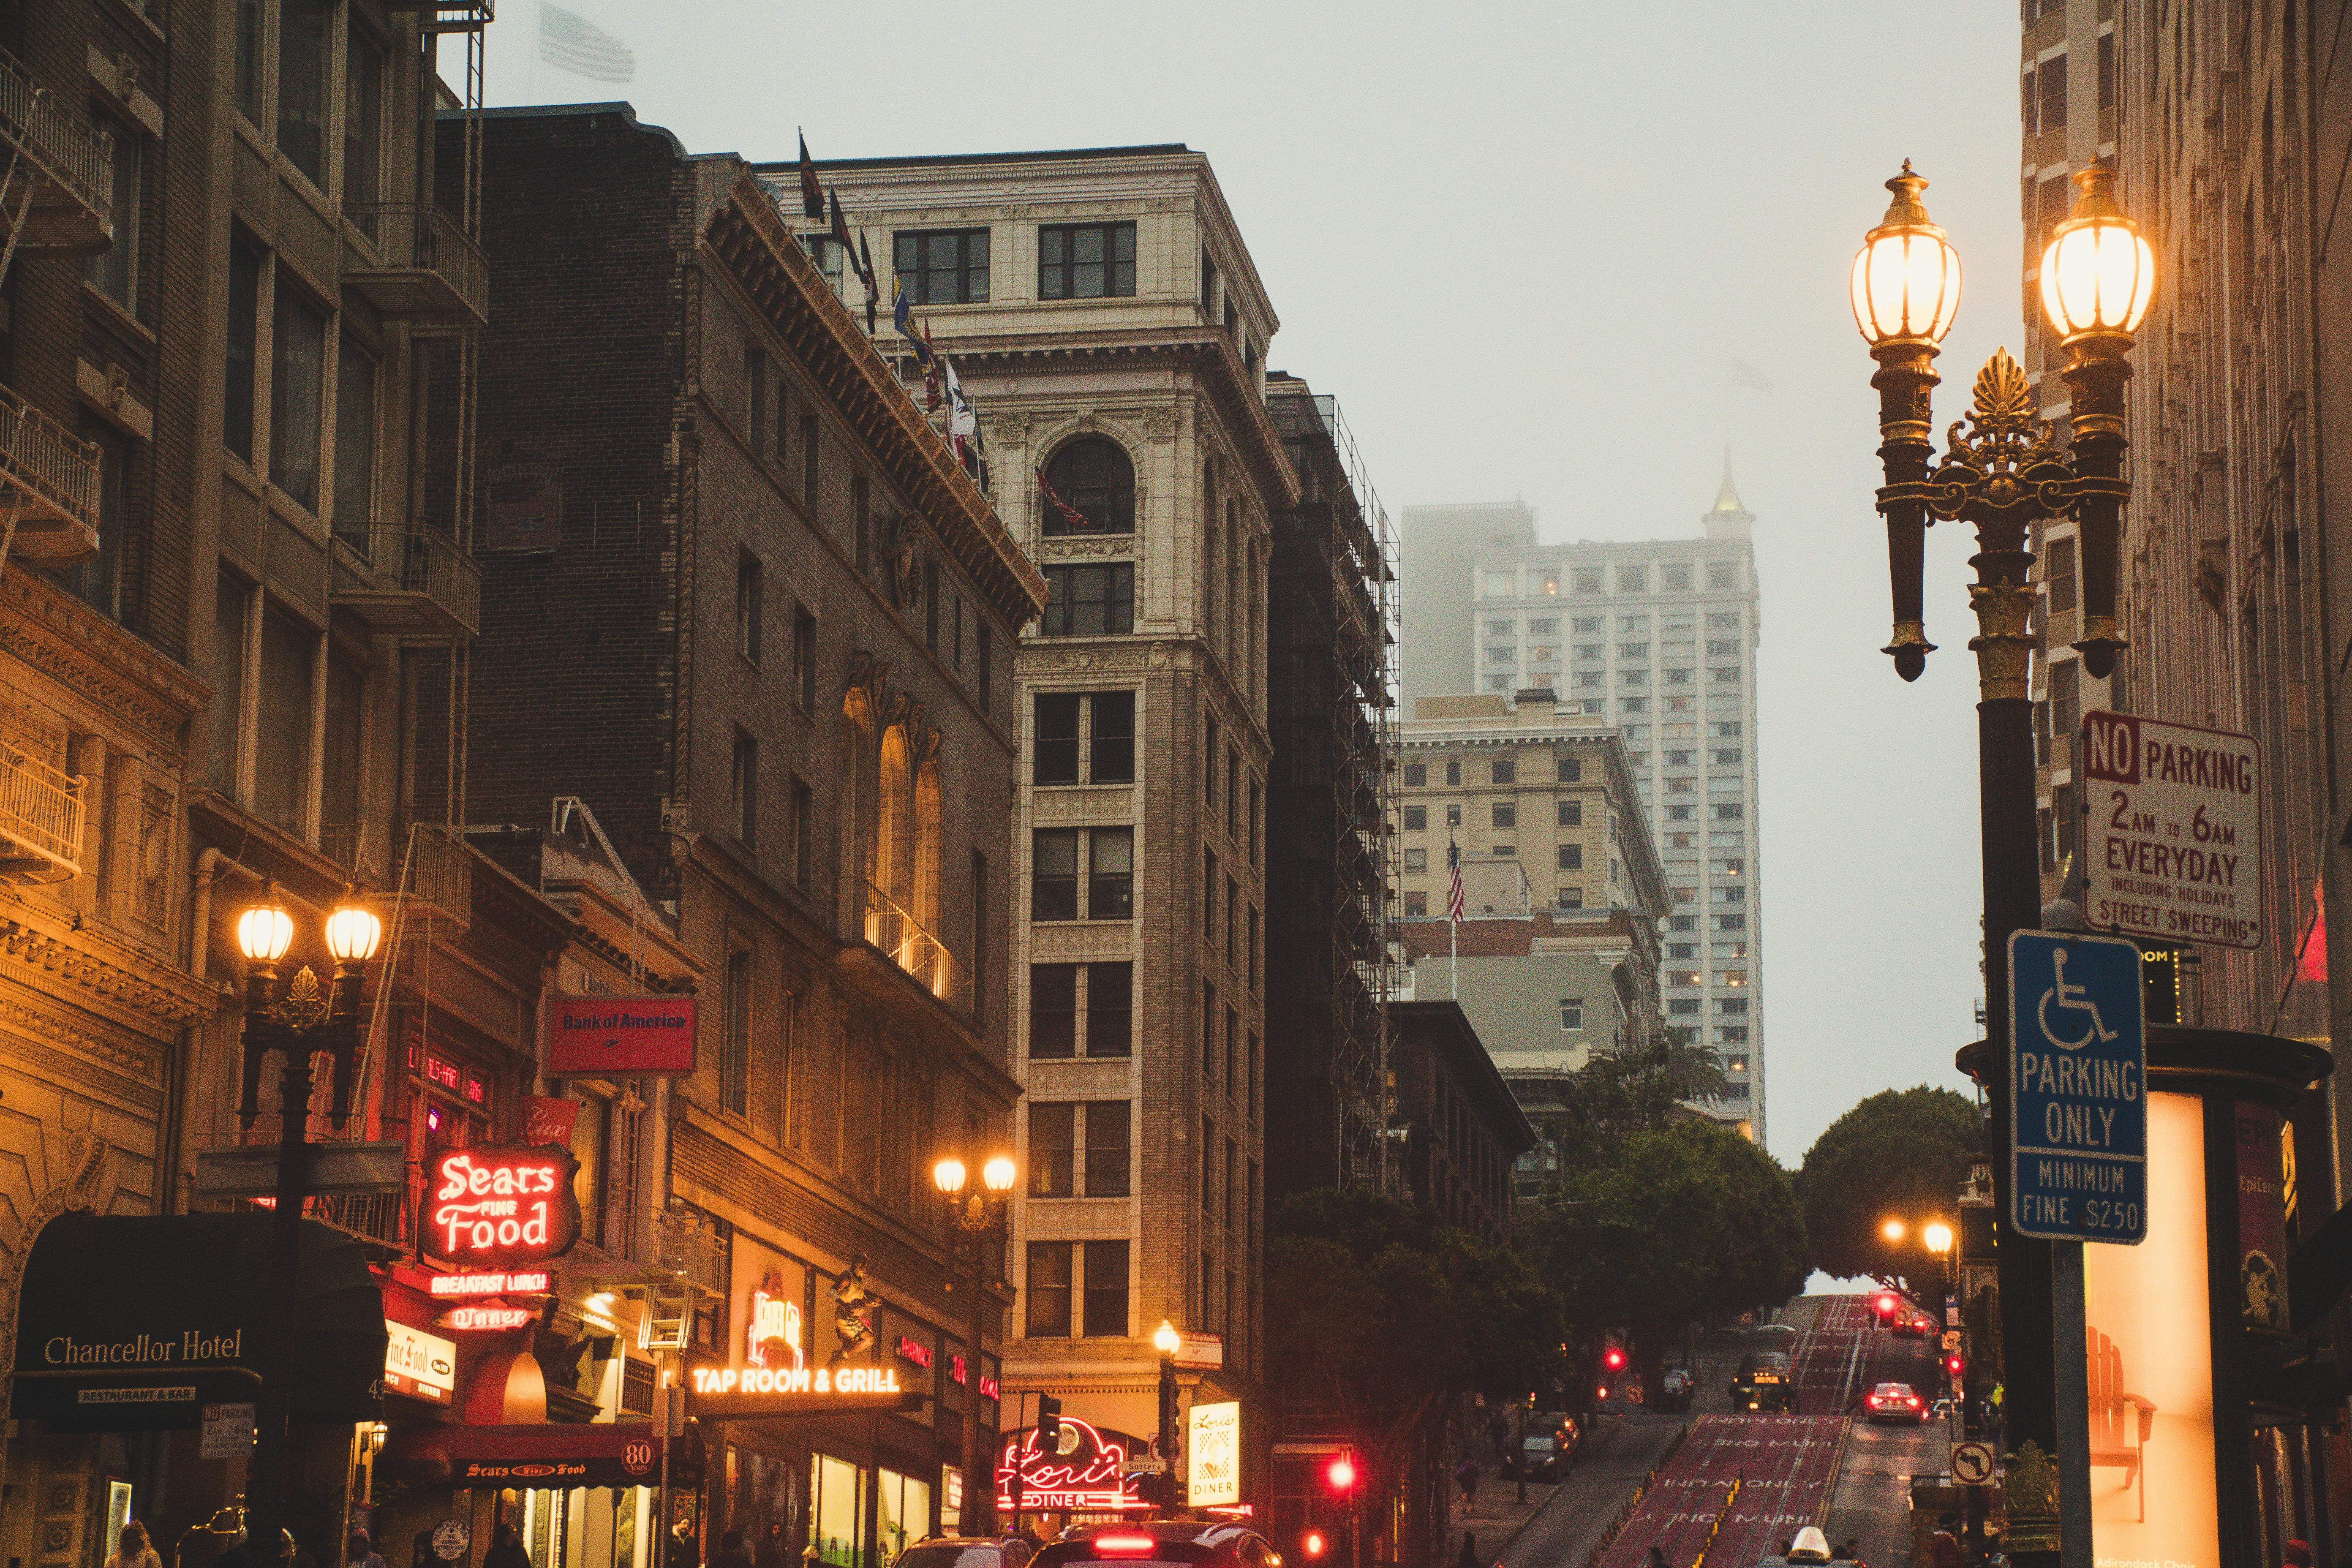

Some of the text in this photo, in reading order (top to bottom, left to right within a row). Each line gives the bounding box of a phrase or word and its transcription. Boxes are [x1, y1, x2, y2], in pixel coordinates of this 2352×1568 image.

[2091, 720, 2251, 794] NO PARKING
[2168, 822, 2180, 837] TO
[2107, 836, 2238, 887] EVERYDAY
[2112, 877, 2235, 908] INCLUDING HOLIDAYS
[2100, 900, 2247, 939] STREET SWEEPING
[2141, 951, 2167, 962] OM
[564, 1013, 685, 1029] Bank of America
[2023, 1053, 2137, 1101] PARKING
[2046, 1102, 2116, 1147] ONLY
[438, 1155, 554, 1200] Sears
[2039, 1160, 2124, 1193] MINIMUM
[481, 1200, 517, 1216] FINE
[2024, 1195, 2138, 1230] FINE $250
[436, 1201, 547, 1252] Food
[431, 1274, 546, 1293] BREAKFAST LUNCH
[44, 1328, 242, 1364] Chancellor Hotel
[418, 1383, 441, 1398] DINNER
[693, 1369, 736, 1393] TAP
[741, 1369, 809, 1393] ROOM
[814, 1369, 830, 1393] &
[836, 1369, 899, 1393] GRILL
[83, 1389, 190, 1401] RESTAURANT & BAR
[1193, 1414, 1234, 1429] Lori's
[626, 1444, 651, 1464] 80
[467, 1463, 509, 1478] Sears
[558, 1464, 585, 1475] Food
[1195, 1482, 1232, 1494] DINER
[1031, 1495, 1086, 1506] DINER
[2096, 1558, 2160, 1568] Adirondack
